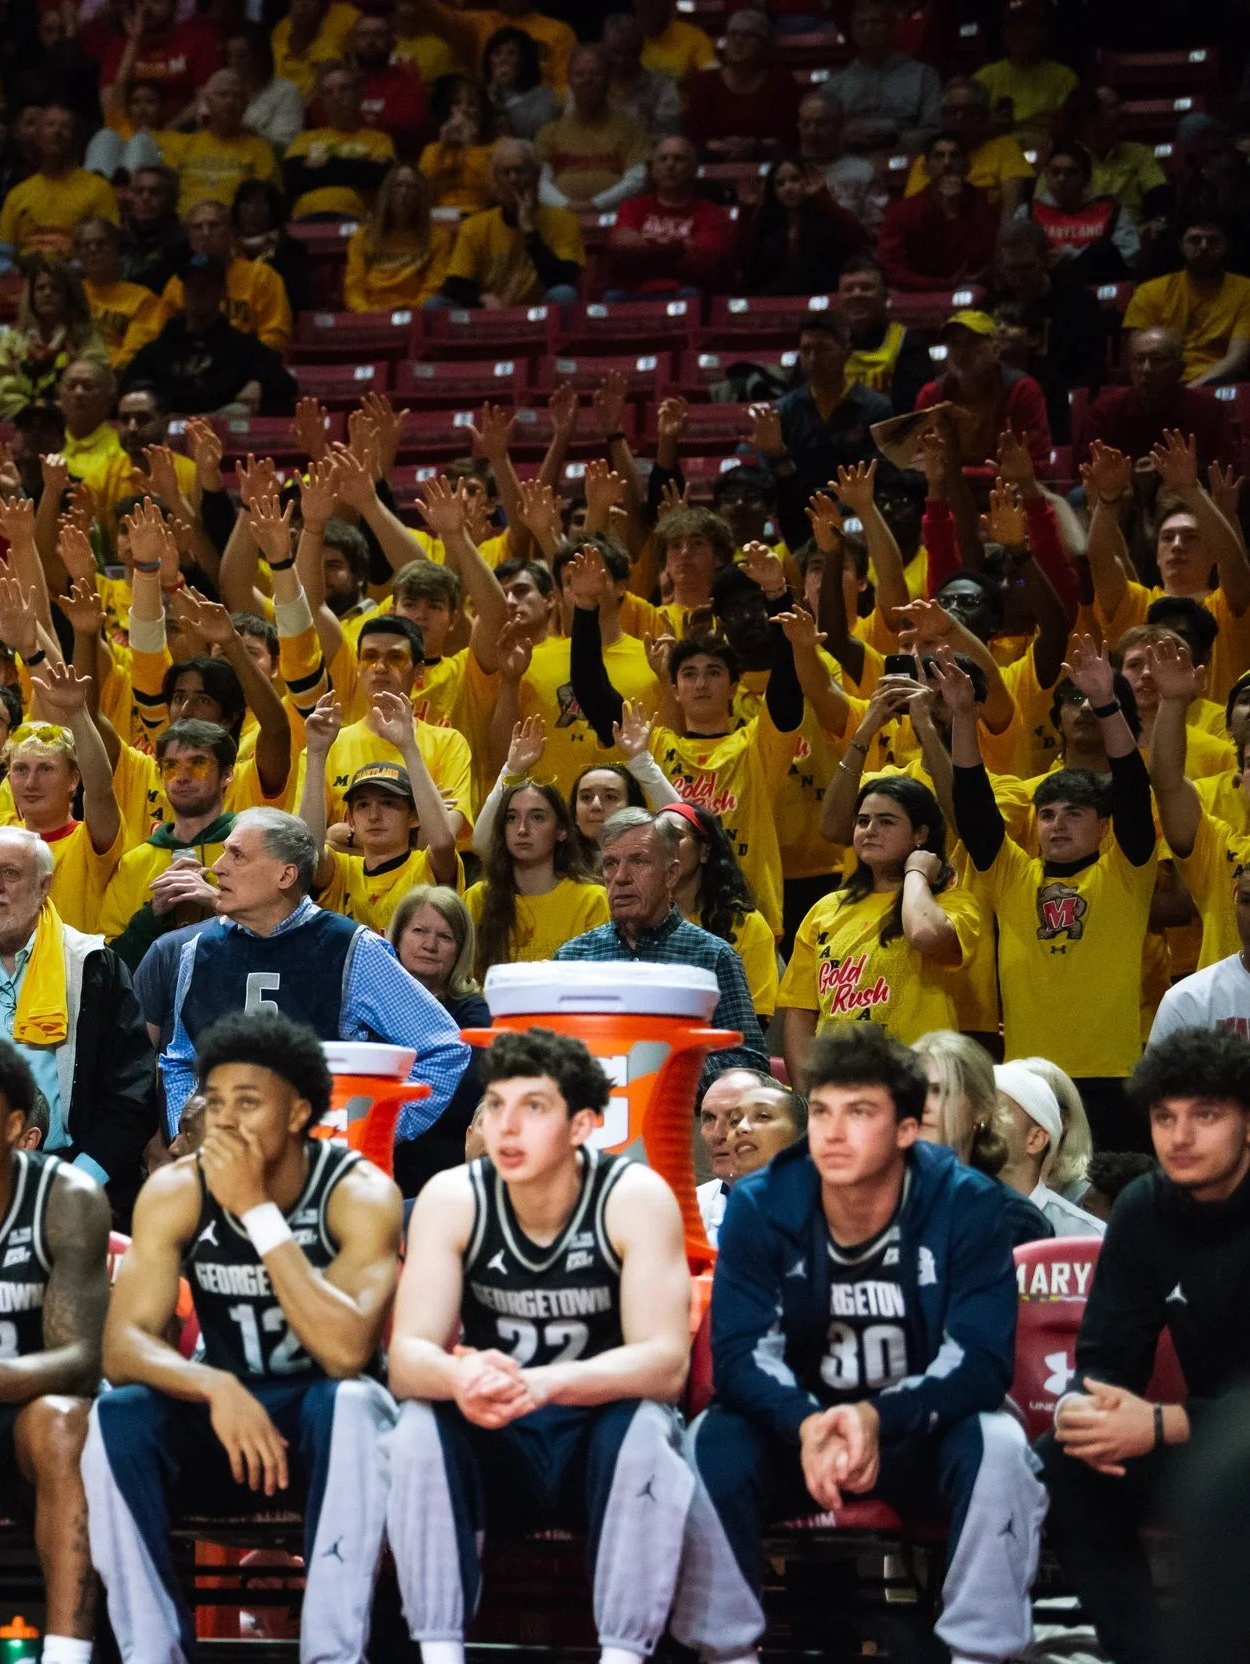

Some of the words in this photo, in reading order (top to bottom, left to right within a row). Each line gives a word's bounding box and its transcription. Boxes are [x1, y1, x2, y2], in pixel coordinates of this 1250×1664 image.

[693, 788, 739, 816] Rsh
[1043, 897, 1077, 932] M
[245, 972, 281, 1020] 5
[819, 953, 868, 996] Gold
[830, 977, 890, 1016] Rush
[470, 1280, 613, 1319] GEORGETOWN
[227, 1303, 313, 1377] 12
[496, 1316, 591, 1369] 22
[819, 1321, 908, 1390] 30
